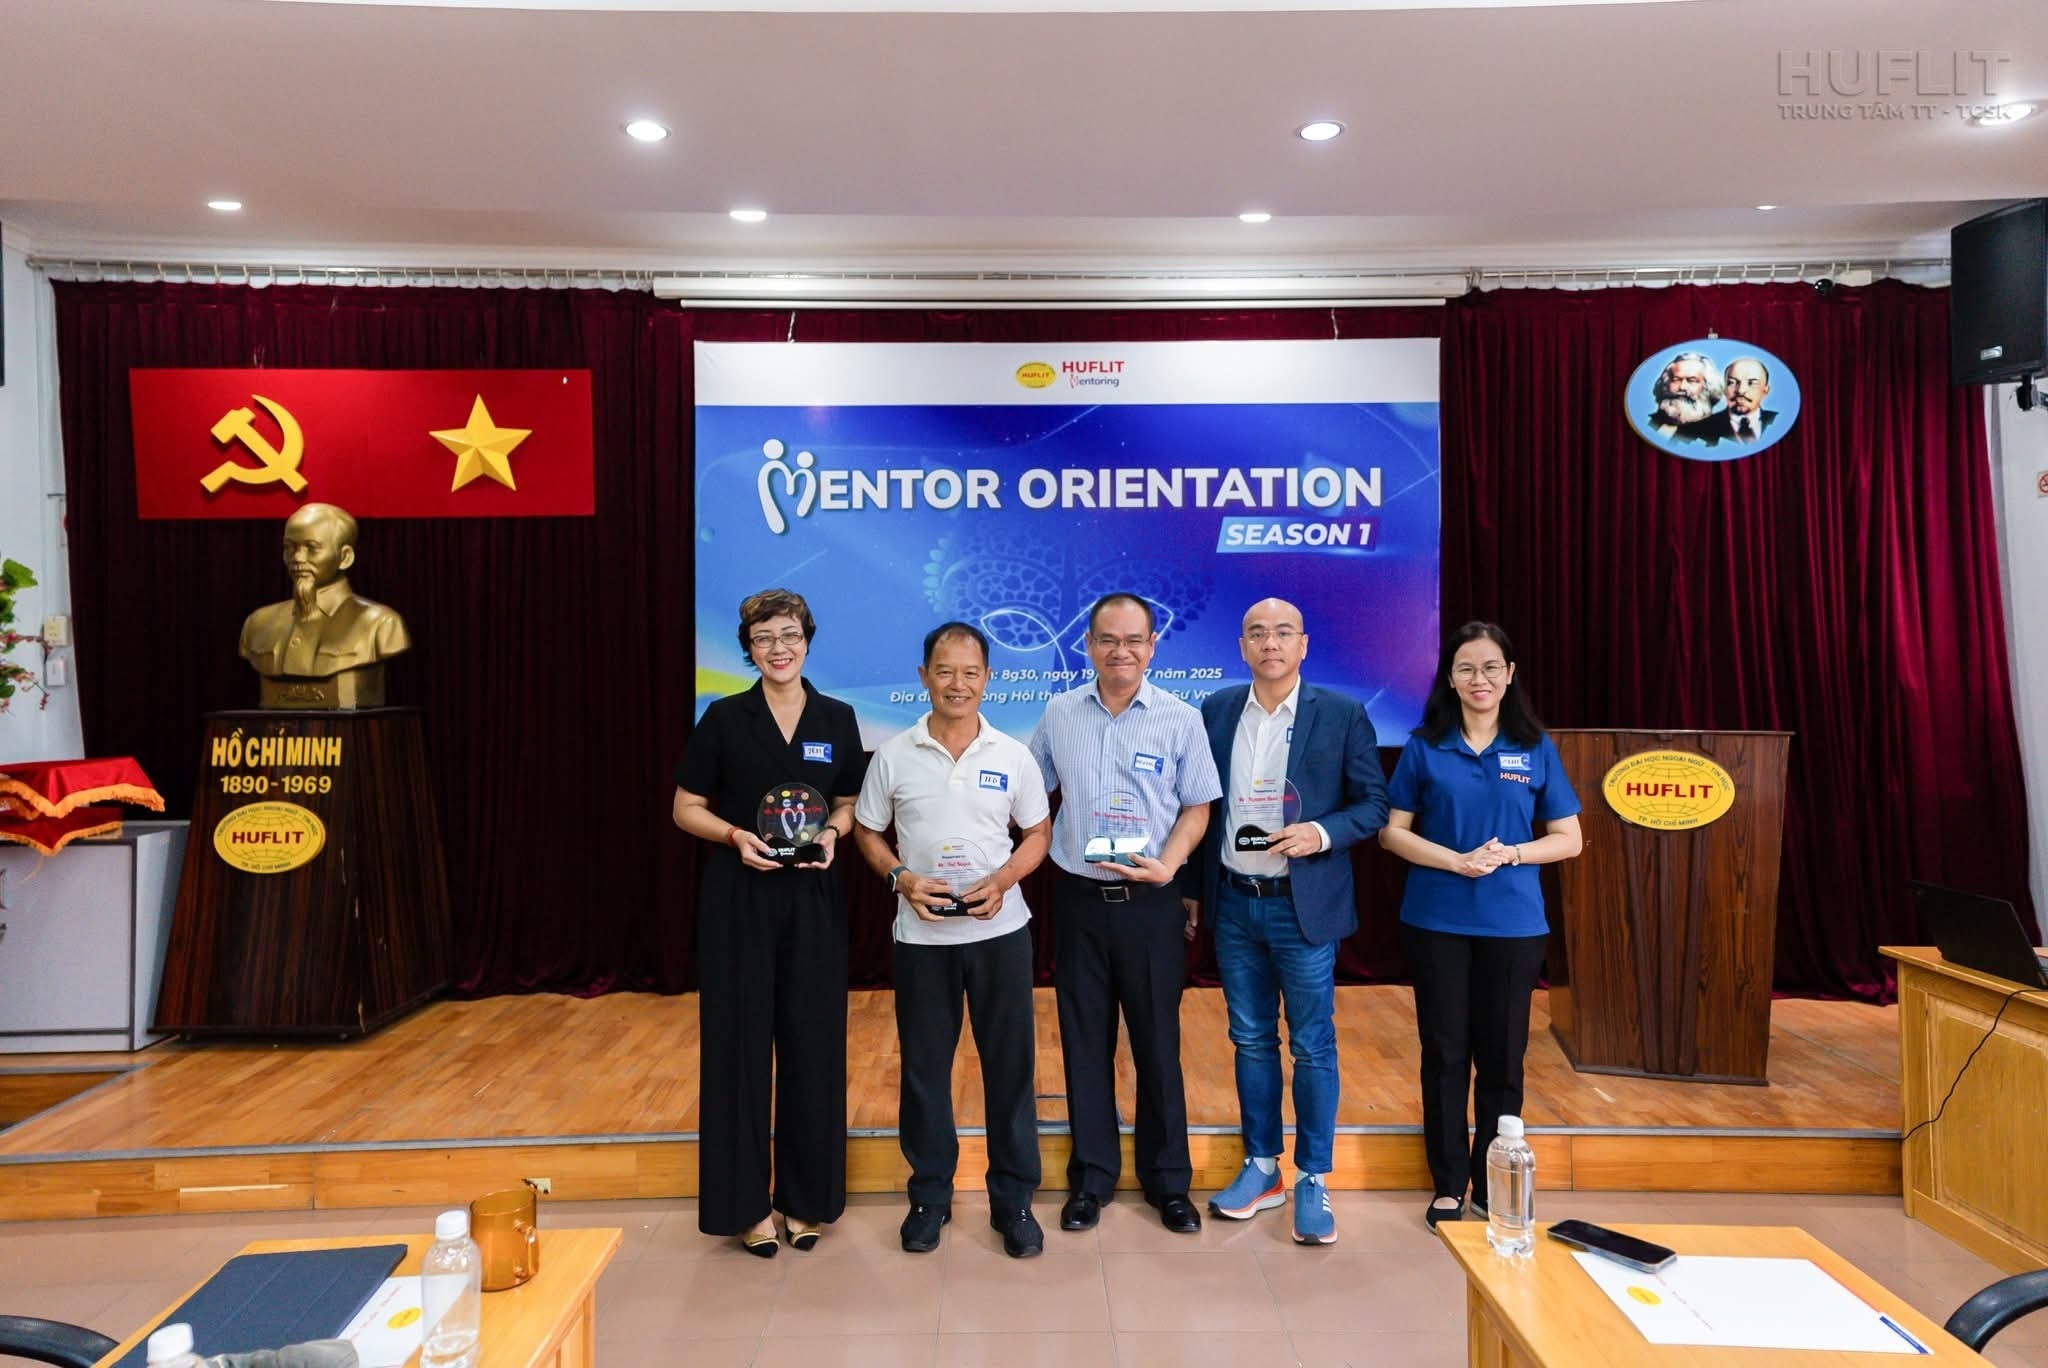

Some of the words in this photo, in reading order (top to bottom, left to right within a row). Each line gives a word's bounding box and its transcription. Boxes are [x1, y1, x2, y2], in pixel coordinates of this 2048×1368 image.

[1062, 360, 1125, 374] HUFLIT
[1018, 467, 1383, 509] ORIENTATION
[1226, 523, 1351, 546] SEASON
[1359, 523, 1371, 546] 1
[1001, 669, 1039, 682] 8g30,
[1155, 668, 1187, 679] năm
[1190, 668, 1223, 679] 2025
[890, 690, 914, 704] Địa
[212, 727, 244, 768] HỒ
[245, 727, 286, 768] CHÍ
[285, 736, 343, 767] MINH
[1500, 772, 1531, 784] HUFLIT
[1626, 782, 1714, 799] HUFLIT
[231, 831, 305, 845] HUFLIT
